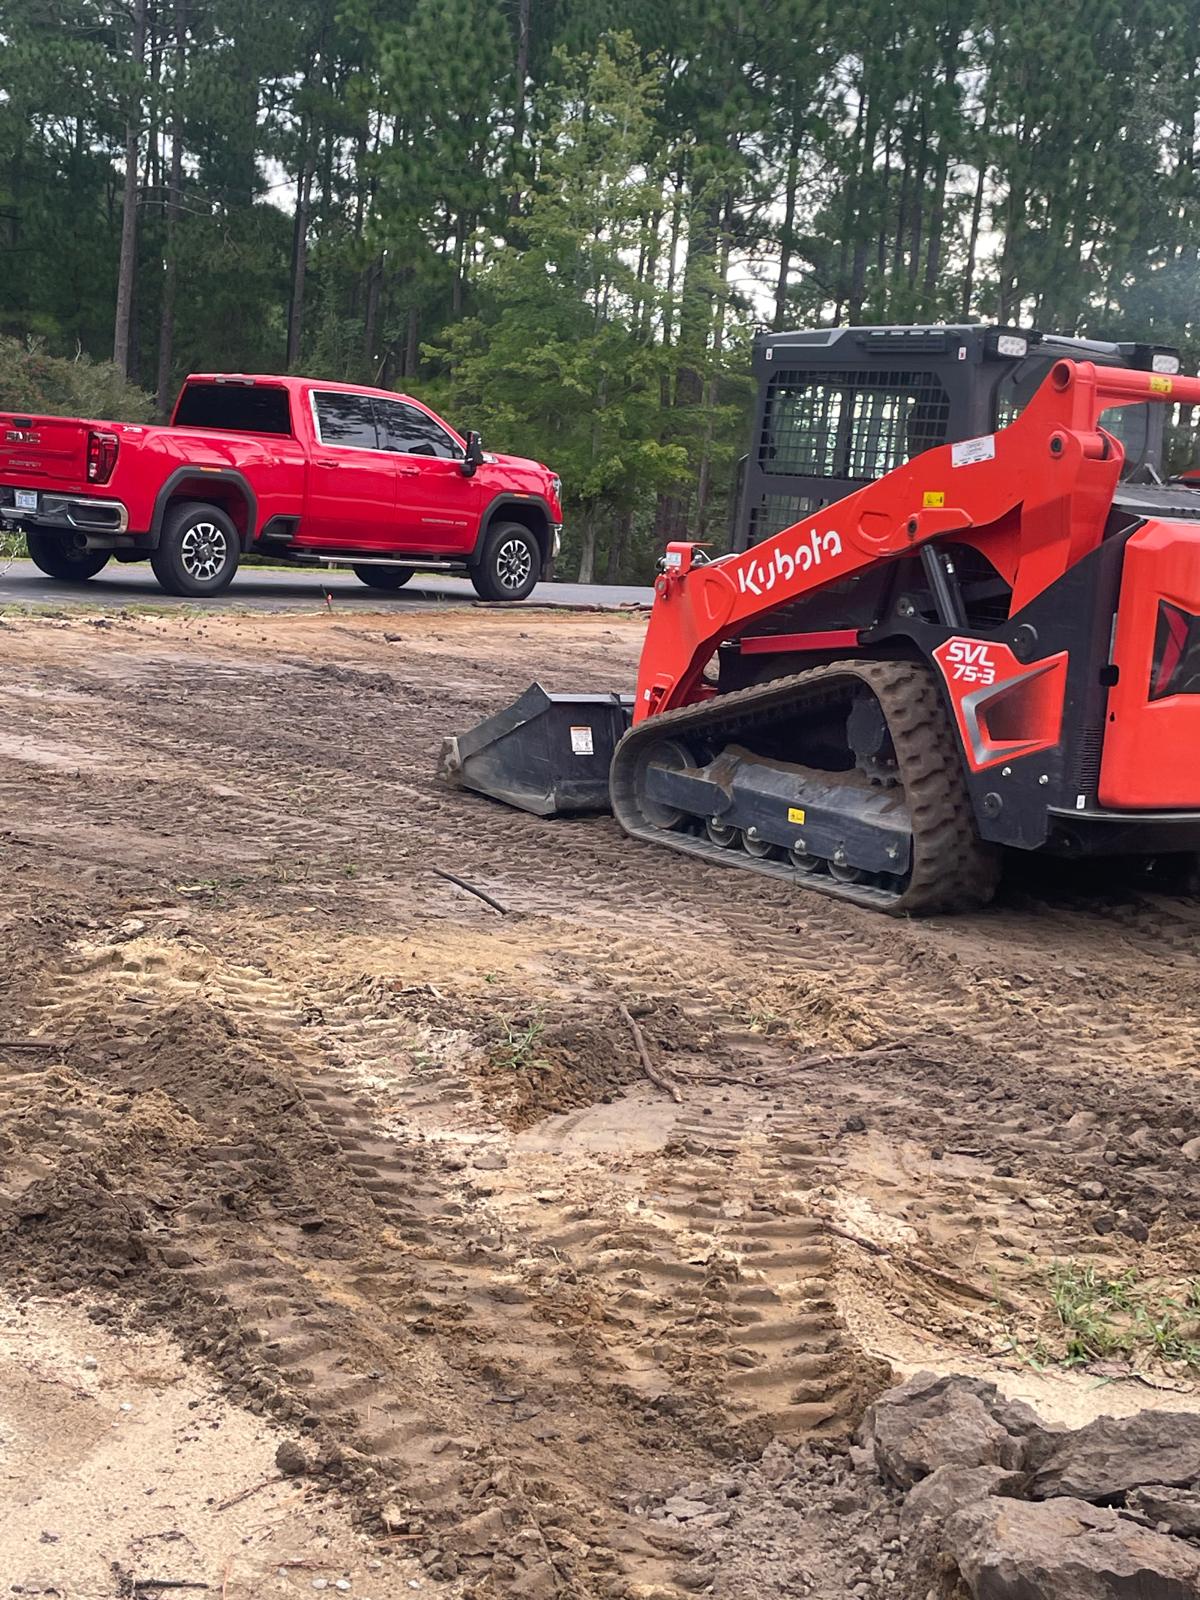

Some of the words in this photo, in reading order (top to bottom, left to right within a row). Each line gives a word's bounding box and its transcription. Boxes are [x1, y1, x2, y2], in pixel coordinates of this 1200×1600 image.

[737, 528, 842, 596] Kubota
[945, 642, 995, 667] SVL
[952, 663, 996, 685] 75-3
